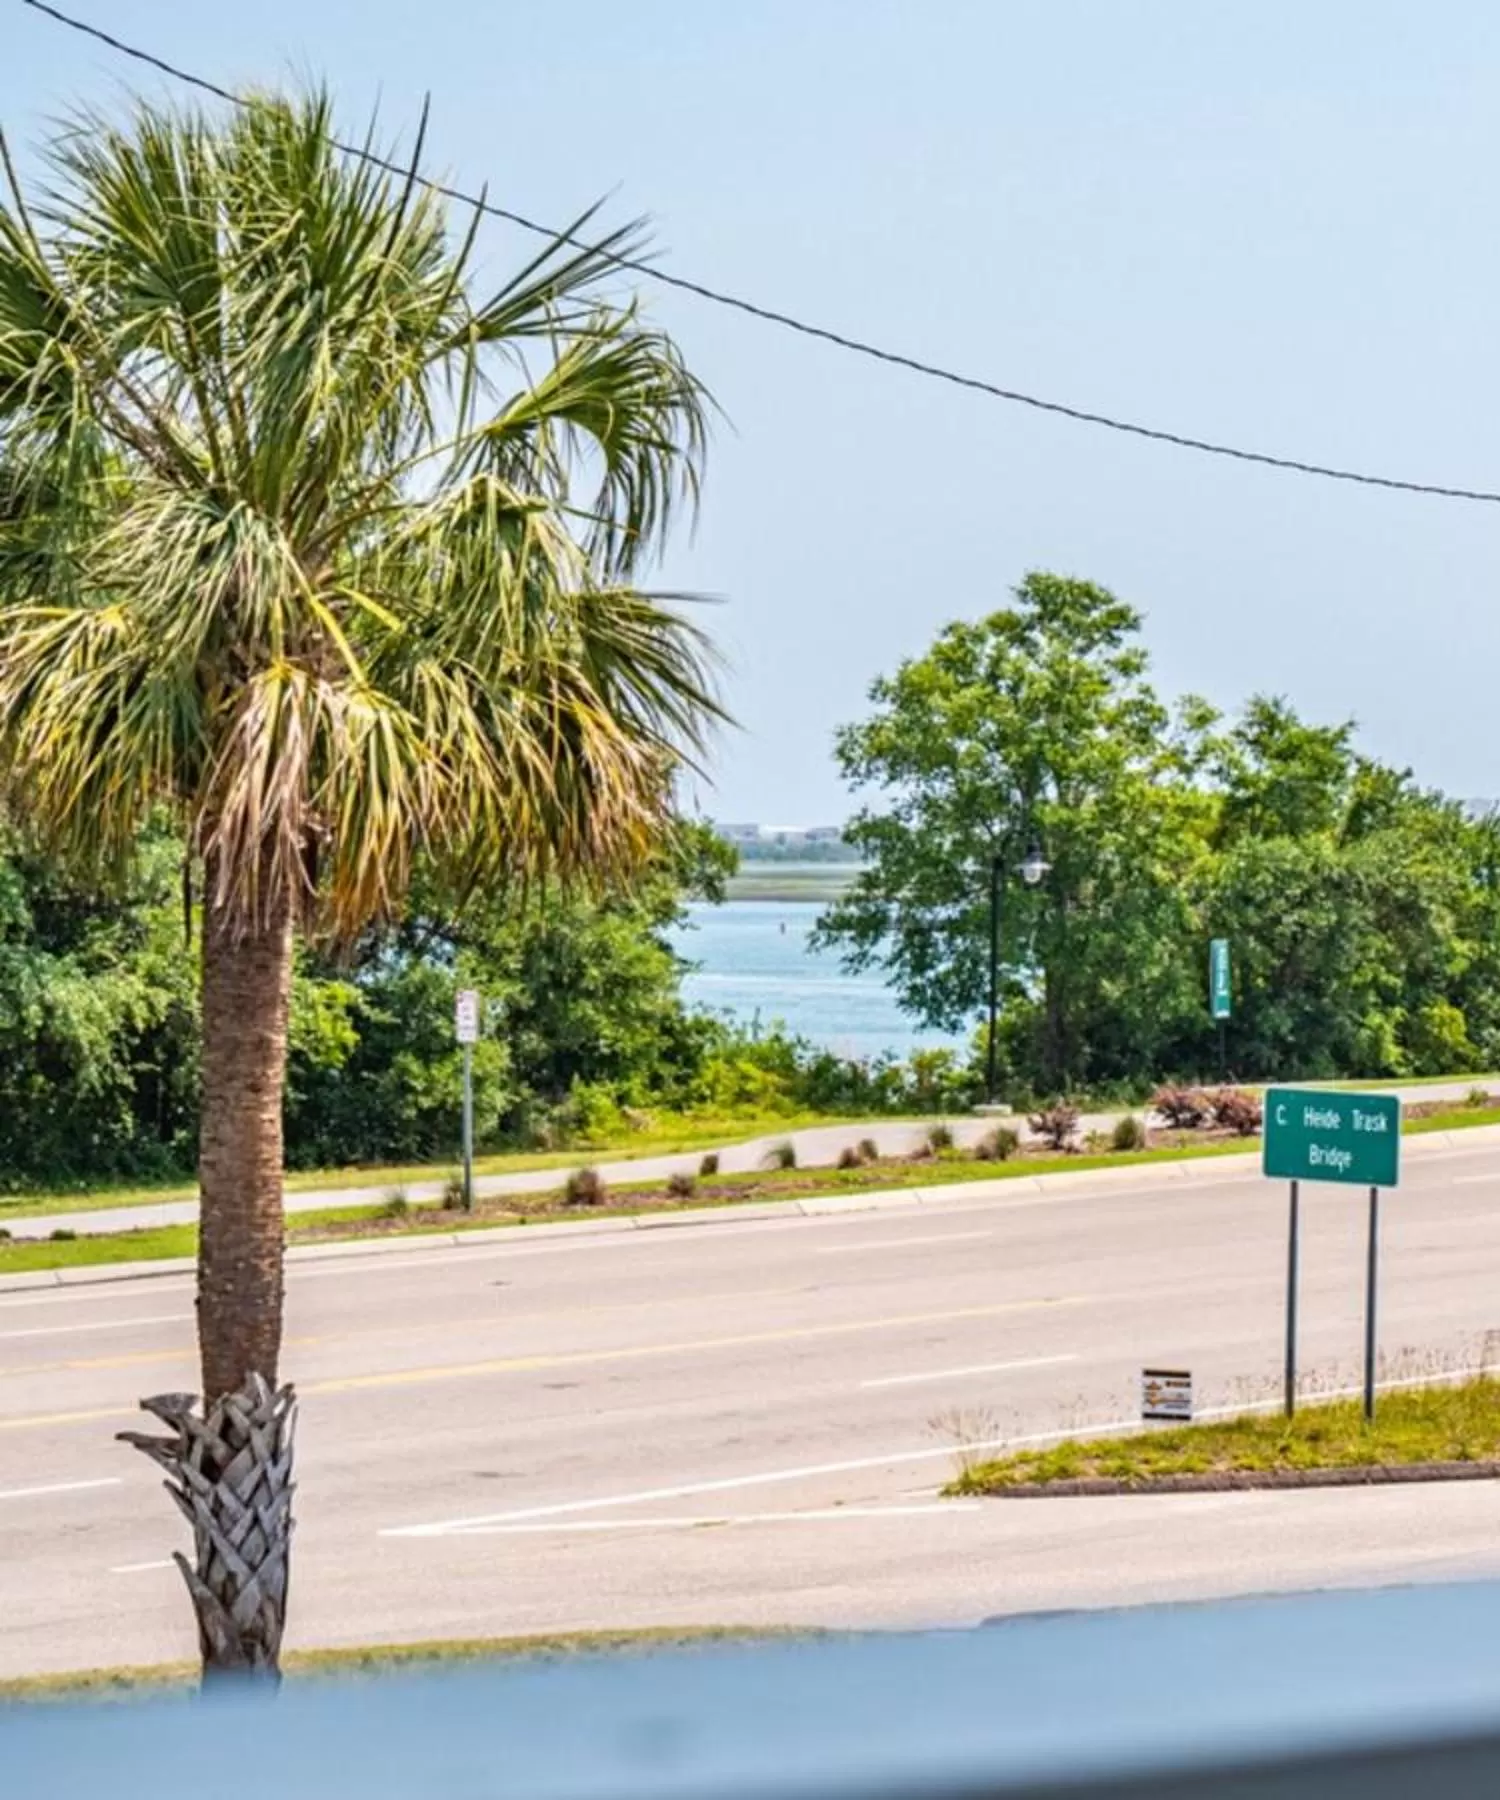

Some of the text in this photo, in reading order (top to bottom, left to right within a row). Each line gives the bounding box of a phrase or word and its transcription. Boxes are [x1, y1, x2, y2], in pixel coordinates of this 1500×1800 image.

[1275, 1104, 1388, 1133] C Heide Trask
[1309, 1143, 1353, 1174] Bridge
